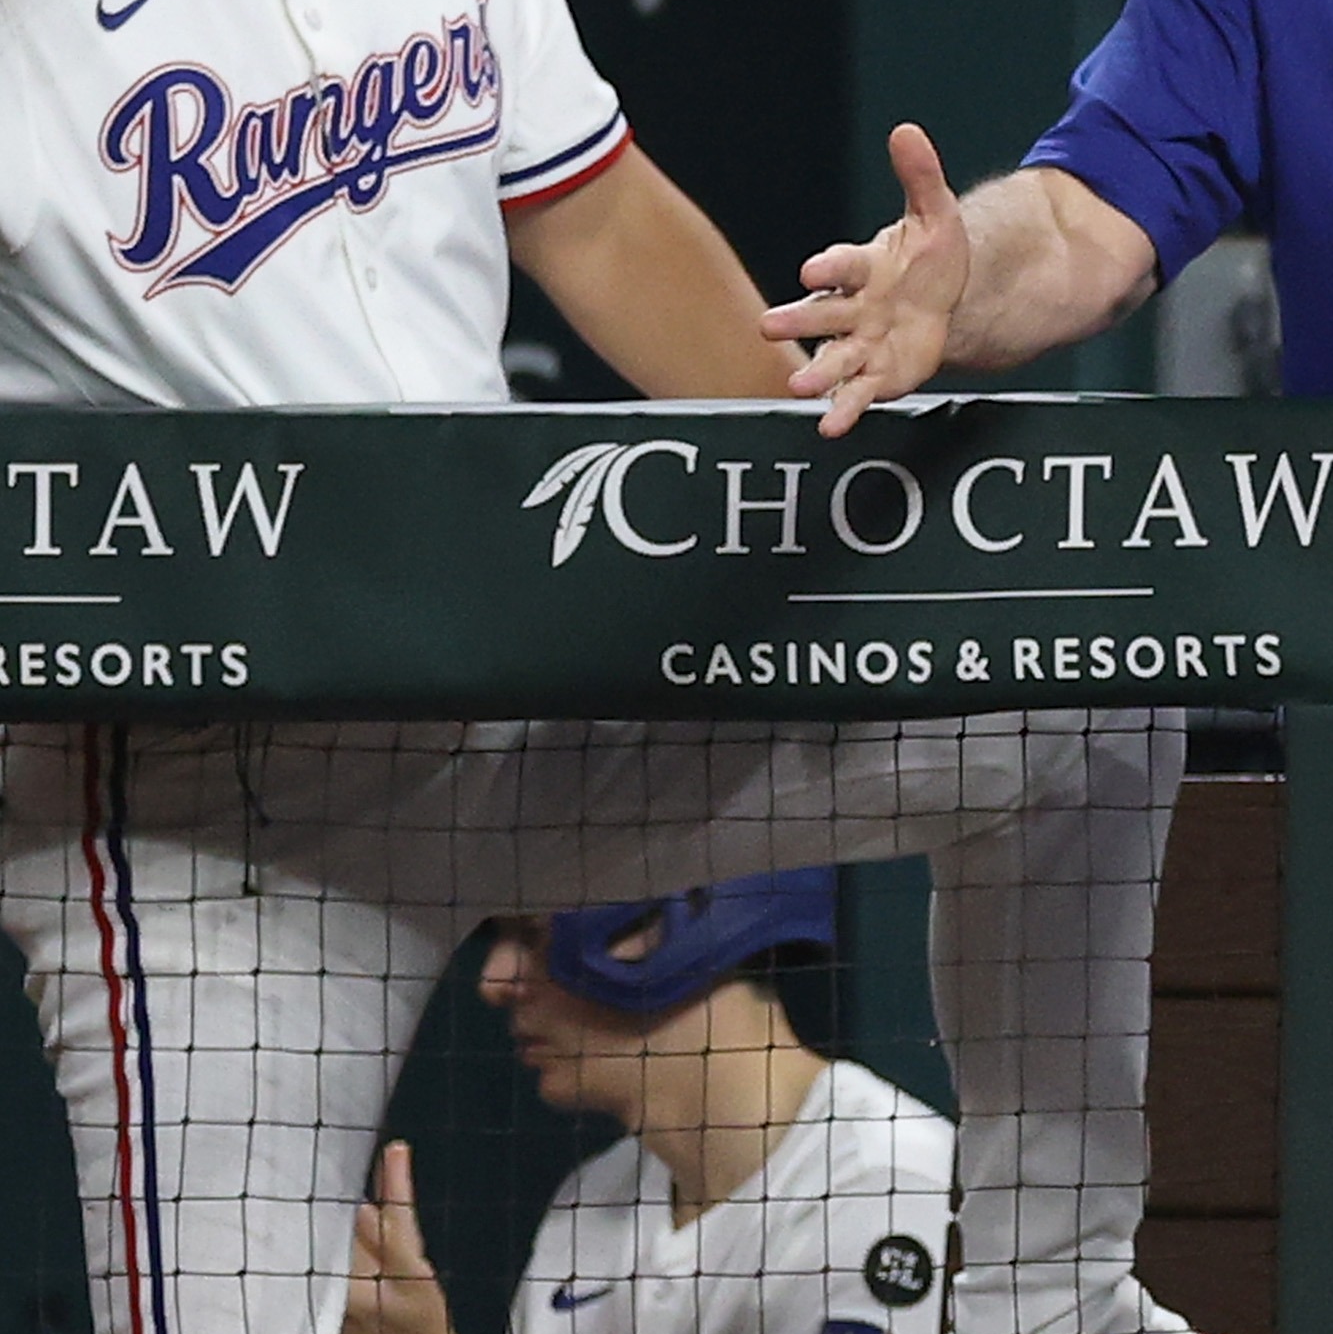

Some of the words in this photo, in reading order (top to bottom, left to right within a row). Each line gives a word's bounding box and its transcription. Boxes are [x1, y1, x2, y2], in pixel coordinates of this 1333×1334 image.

[7, 462, 305, 557] TAW
[661, 641, 934, 685] CASINOS
[956, 639, 990, 682] &
[1013, 634, 1282, 680] RESORTS
